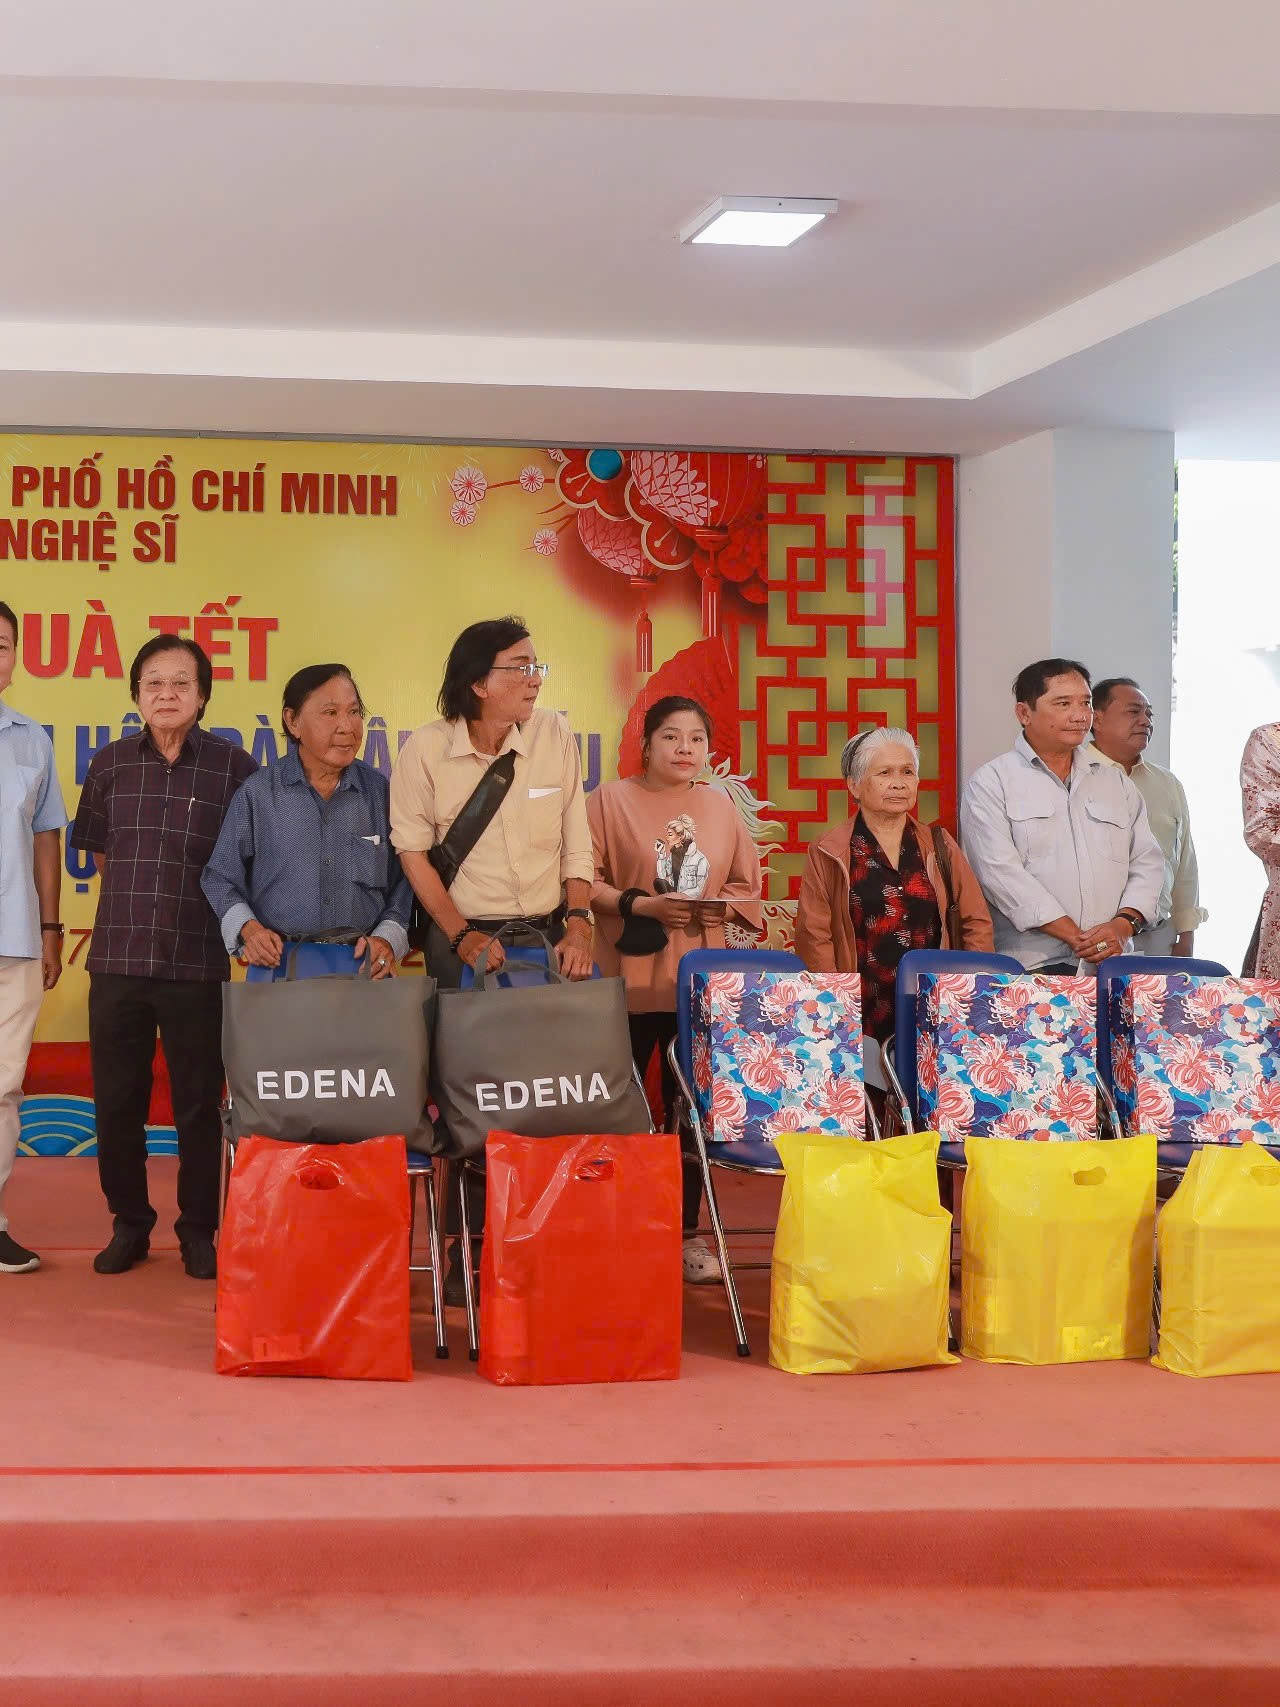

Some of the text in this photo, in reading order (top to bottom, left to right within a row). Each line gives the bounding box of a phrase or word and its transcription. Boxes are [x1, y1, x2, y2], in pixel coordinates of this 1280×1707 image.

[11, 452, 104, 509] PHỐ
[117, 454, 176, 510] HỒ
[191, 463, 266, 513] CHÍ
[280, 472, 397, 515] MINH
[133, 513, 180, 563] SĨ
[22, 600, 124, 679] UÀ
[256, 1069, 396, 1100] EDENA
[475, 1072, 610, 1111] EDENA
